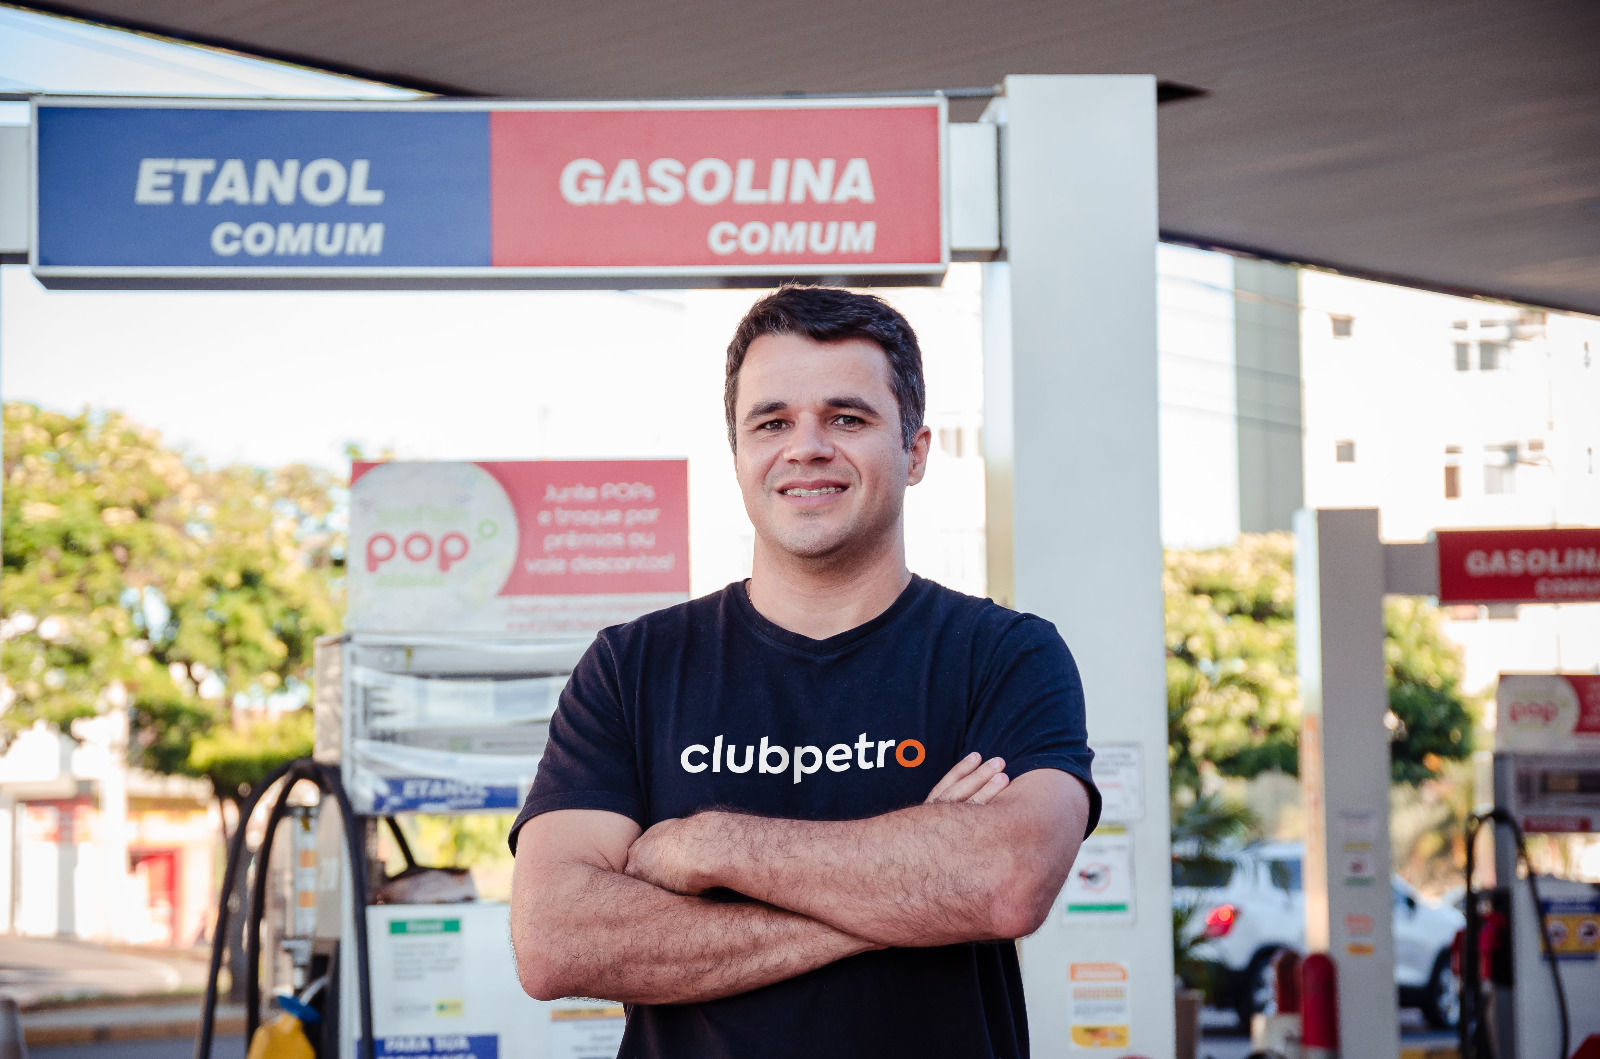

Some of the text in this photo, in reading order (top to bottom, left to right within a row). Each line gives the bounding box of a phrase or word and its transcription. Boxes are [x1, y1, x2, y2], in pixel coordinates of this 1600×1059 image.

[134, 157, 385, 207] ETANOL
[559, 157, 876, 207] GASOLINA
[210, 221, 385, 257] COMUM
[707, 220, 877, 257] COMUM
[543, 482, 655, 503] Junte POPs
[537, 507, 660, 528] e troque por
[365, 530, 471, 573] pop
[543, 530, 656, 552] prêmios ou
[524, 555, 567, 574] vale
[1464, 548, 1600, 577] GASOLIN
[680, 732, 926, 785] clubpetro
